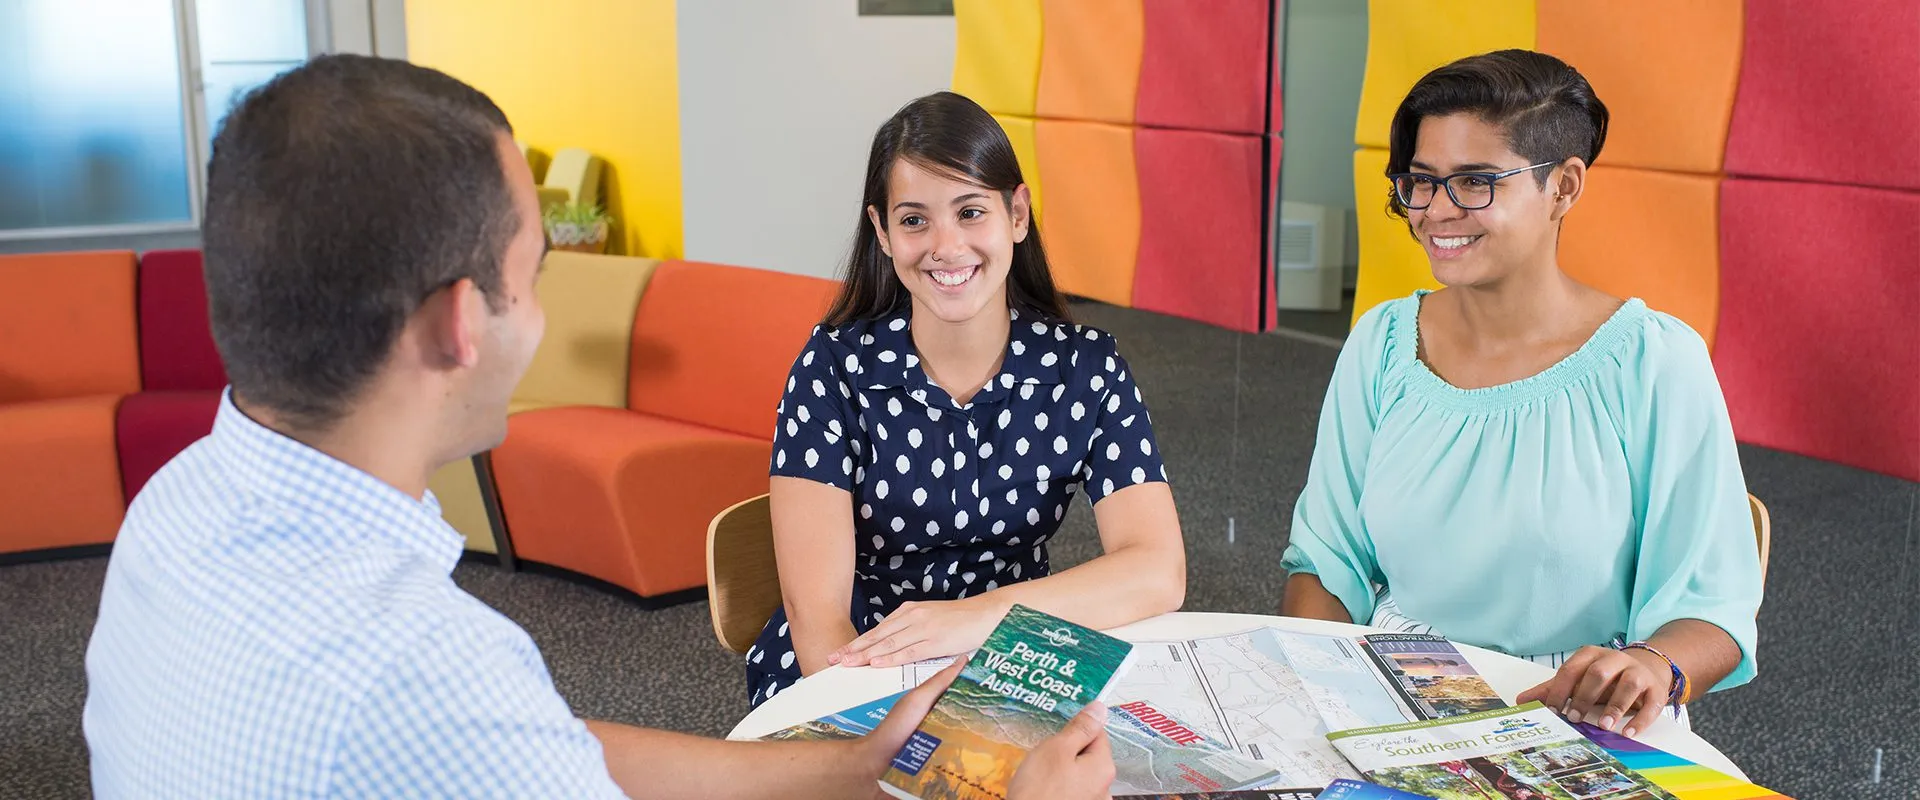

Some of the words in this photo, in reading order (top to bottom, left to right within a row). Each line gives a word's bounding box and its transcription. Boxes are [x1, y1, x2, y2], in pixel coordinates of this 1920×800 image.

[984, 652, 1029, 680] West
[1028, 669, 1084, 701] Coast
[1010, 641, 1059, 671] Perth
[1059, 659, 1077, 678] &
[979, 674, 1058, 713] Australia
[1490, 707, 1521, 716] WALPOLE
[1120, 701, 1205, 746] BROOME
[1385, 740, 1475, 757] Southern
[1482, 726, 1551, 744] Forests
[1354, 738, 1401, 751] Explore
[1403, 735, 1419, 744] the
